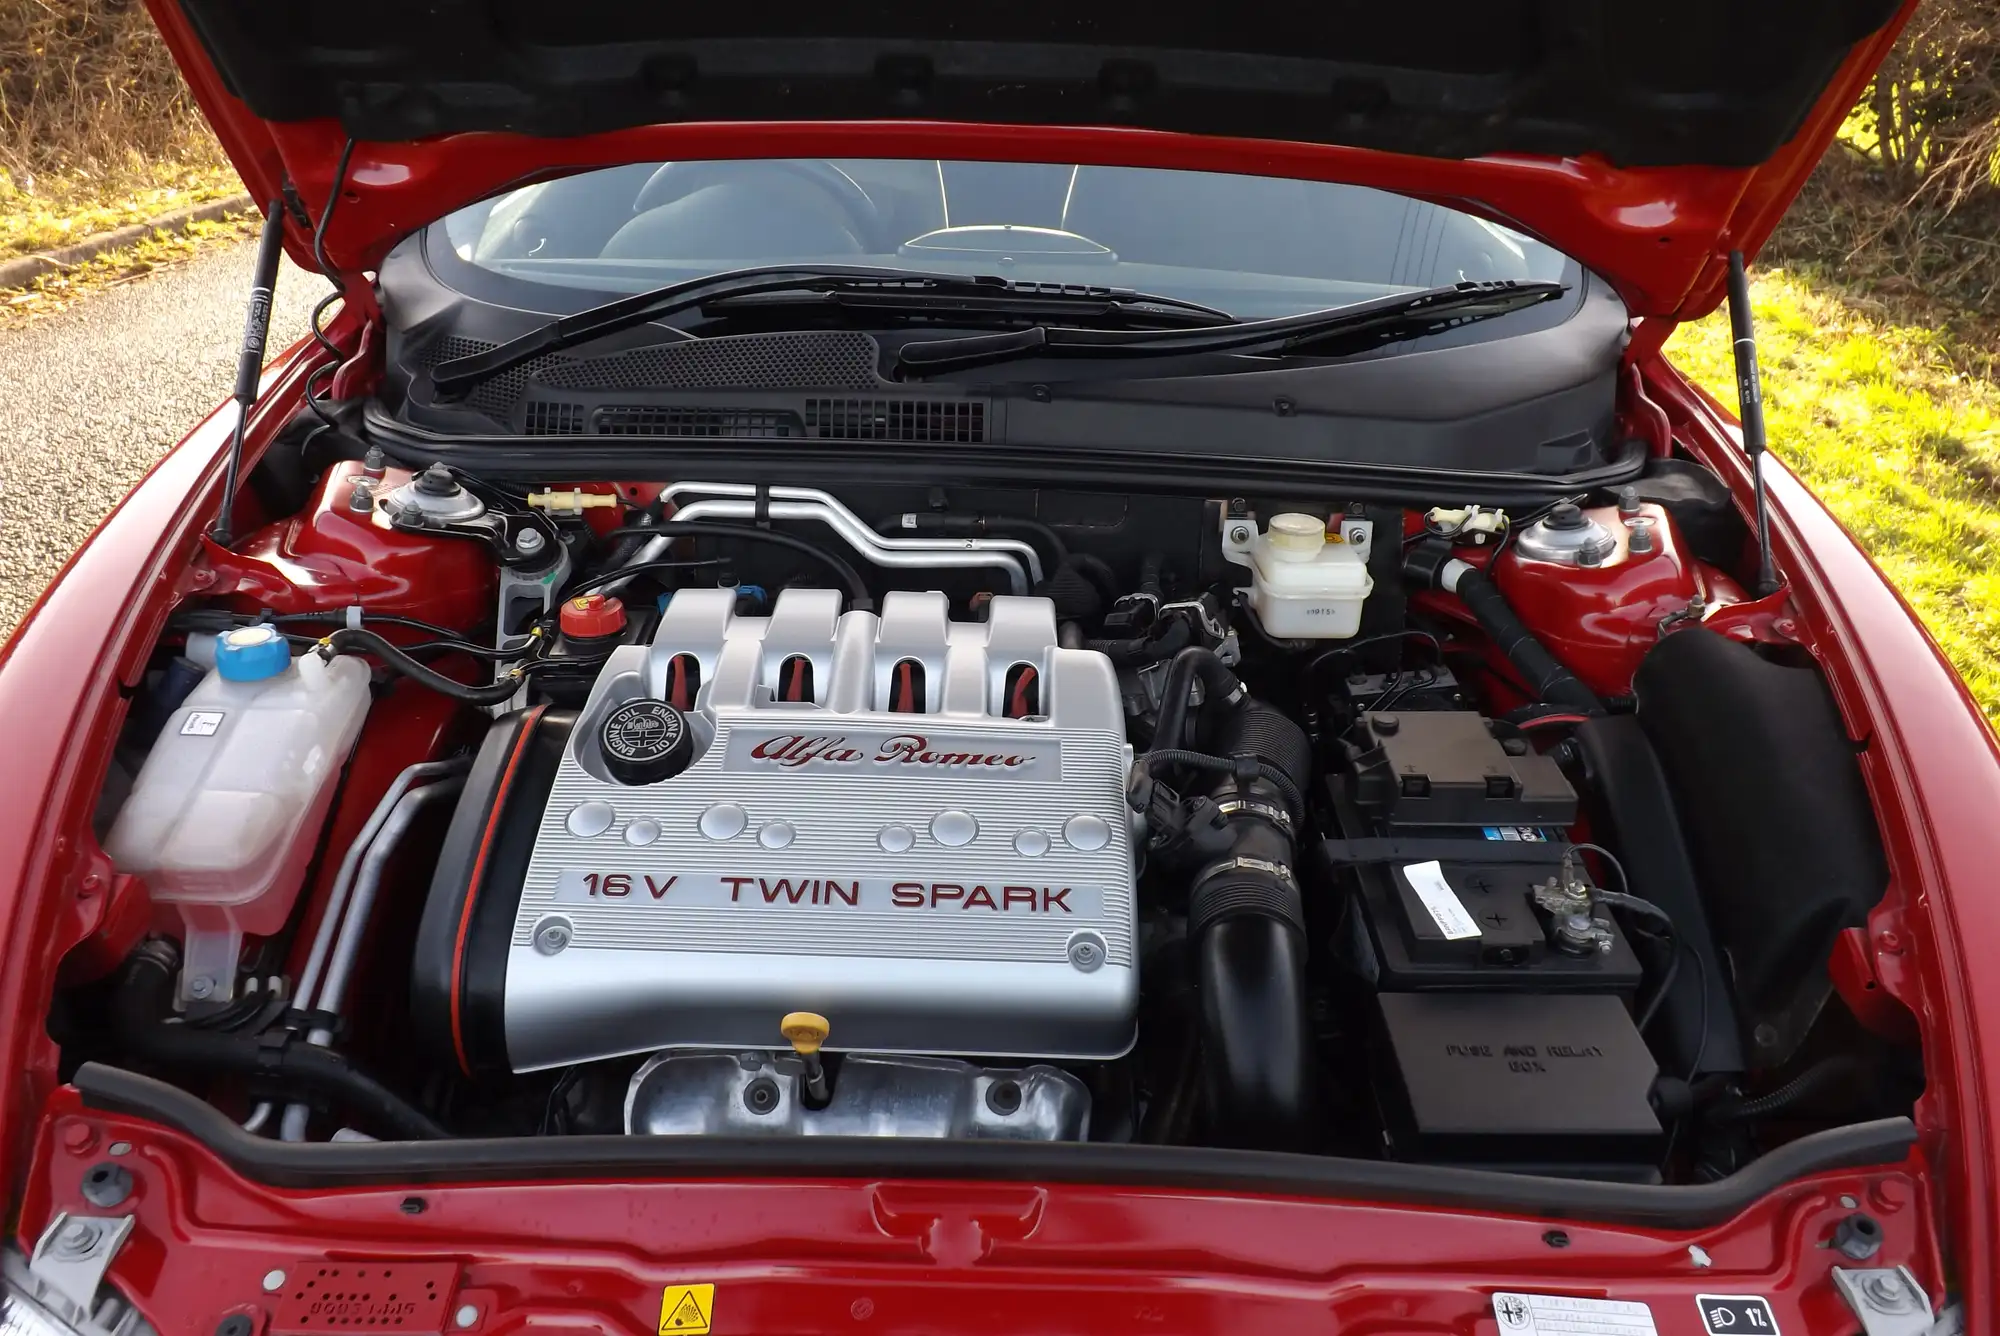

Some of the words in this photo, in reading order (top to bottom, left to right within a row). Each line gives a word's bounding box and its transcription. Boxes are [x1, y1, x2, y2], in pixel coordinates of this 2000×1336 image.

[618, 708, 640, 722] OIL
[651, 706, 679, 739] ENGINE
[608, 722, 636, 757] ENGINE
[647, 740, 670, 754] OIL
[750, 734, 865, 769] Alfa
[873, 733, 1037, 770] Romeo
[719, 876, 860, 907] TWIN
[890, 882, 1074, 914] SPARK
[1446, 1045, 1493, 1058] FUSE
[1503, 1045, 1538, 1058] AND
[1546, 1045, 1604, 1058] RELAY
[1507, 1061, 1547, 1073] BOX
[1745, 1308, 1768, 1327] 1%
